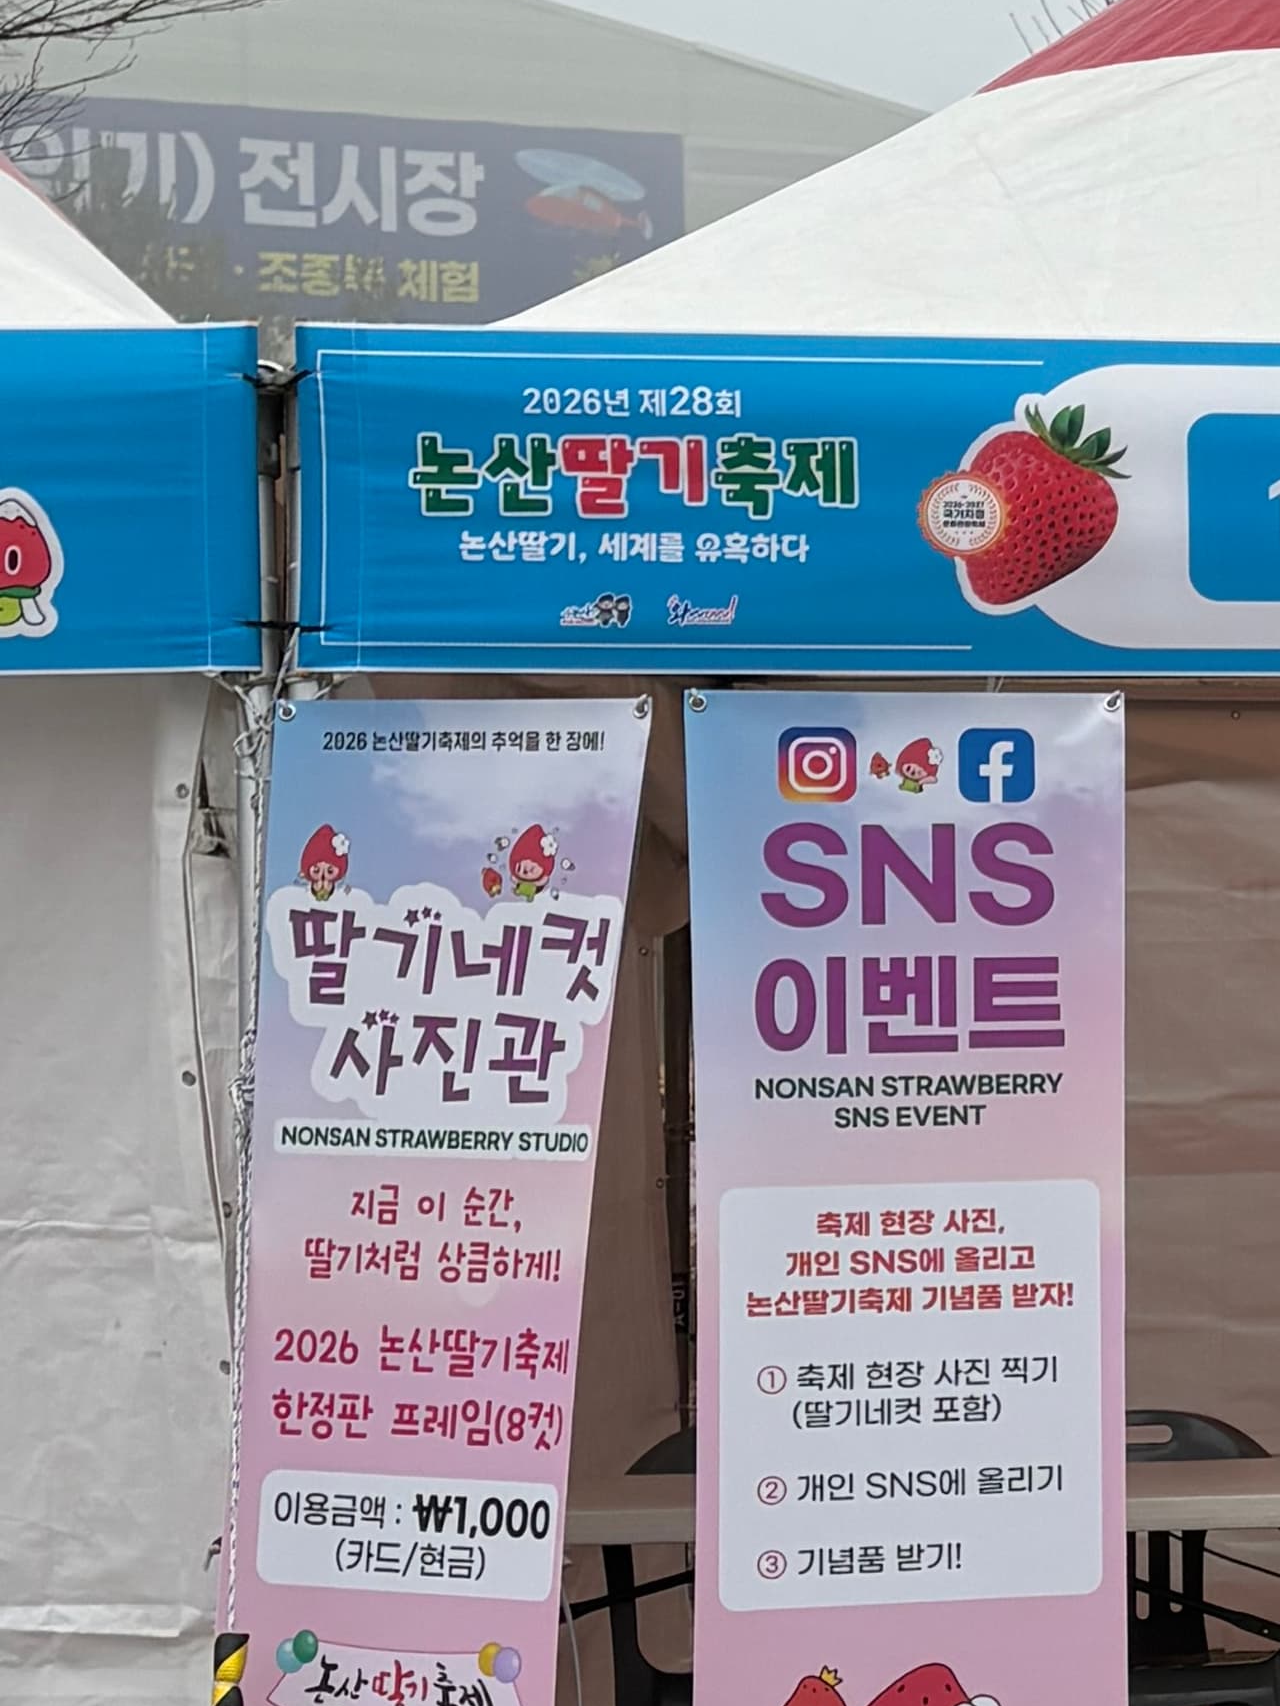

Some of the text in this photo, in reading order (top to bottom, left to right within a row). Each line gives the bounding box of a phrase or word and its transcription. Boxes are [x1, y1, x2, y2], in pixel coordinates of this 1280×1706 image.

[239, 137, 484, 236] 전시장
[397, 259, 479, 303] 체험
[523, 386, 741, 418] 2026년 제28회
[409, 432, 859, 520] 논산딸기축제
[459, 531, 809, 563] 논산딸기, 세계를 유혹하다
[322, 730, 605, 752] 2026 논산딸기축제의 추억을 한 장에!
[761, 821, 1056, 928] SNS
[288, 906, 611, 1005] 딸기네컷
[755, 955, 1065, 1055] 이벤트
[329, 1009, 566, 1104] 사진관
[755, 1072, 1064, 1100] NONSAN STRAWBERRY
[834, 1104, 986, 1129] SNS EVENT
[281, 1126, 589, 1153] NONSAN STRAWBERRY STUDIO
[351, 1184, 523, 1232] 지금 이 순간,
[816, 1207, 1005, 1238] 축제 현장 사진,
[305, 1237, 561, 1283] 딸기처럼 상큼하게!
[785, 1245, 1036, 1278] 개인 SNS에 올리고
[746, 1282, 1075, 1318] 논산딸기축제 기념품 받자!
[274, 1325, 570, 1380] 2026 논산딸기축제
[796, 1362, 855, 1393] 축제
[865, 1359, 924, 1390] 현장
[934, 1357, 991, 1387] 사진
[1001, 1356, 1059, 1384] 찍기
[272, 1389, 564, 1451] 한정판 프레임(8컷)
[792, 1393, 1003, 1430] (딸기네컷 포함)
[796, 1473, 855, 1503] 개인
[865, 1469, 967, 1499] SNS에
[977, 1465, 1064, 1495] 올리기
[274, 1490, 386, 1530] 이용금액
[413, 1494, 551, 1540] ₩1,000
[335, 1537, 487, 1581] (카드/현금)
[797, 1546, 886, 1577] 기념품
[896, 1541, 962, 1573] 받기!
